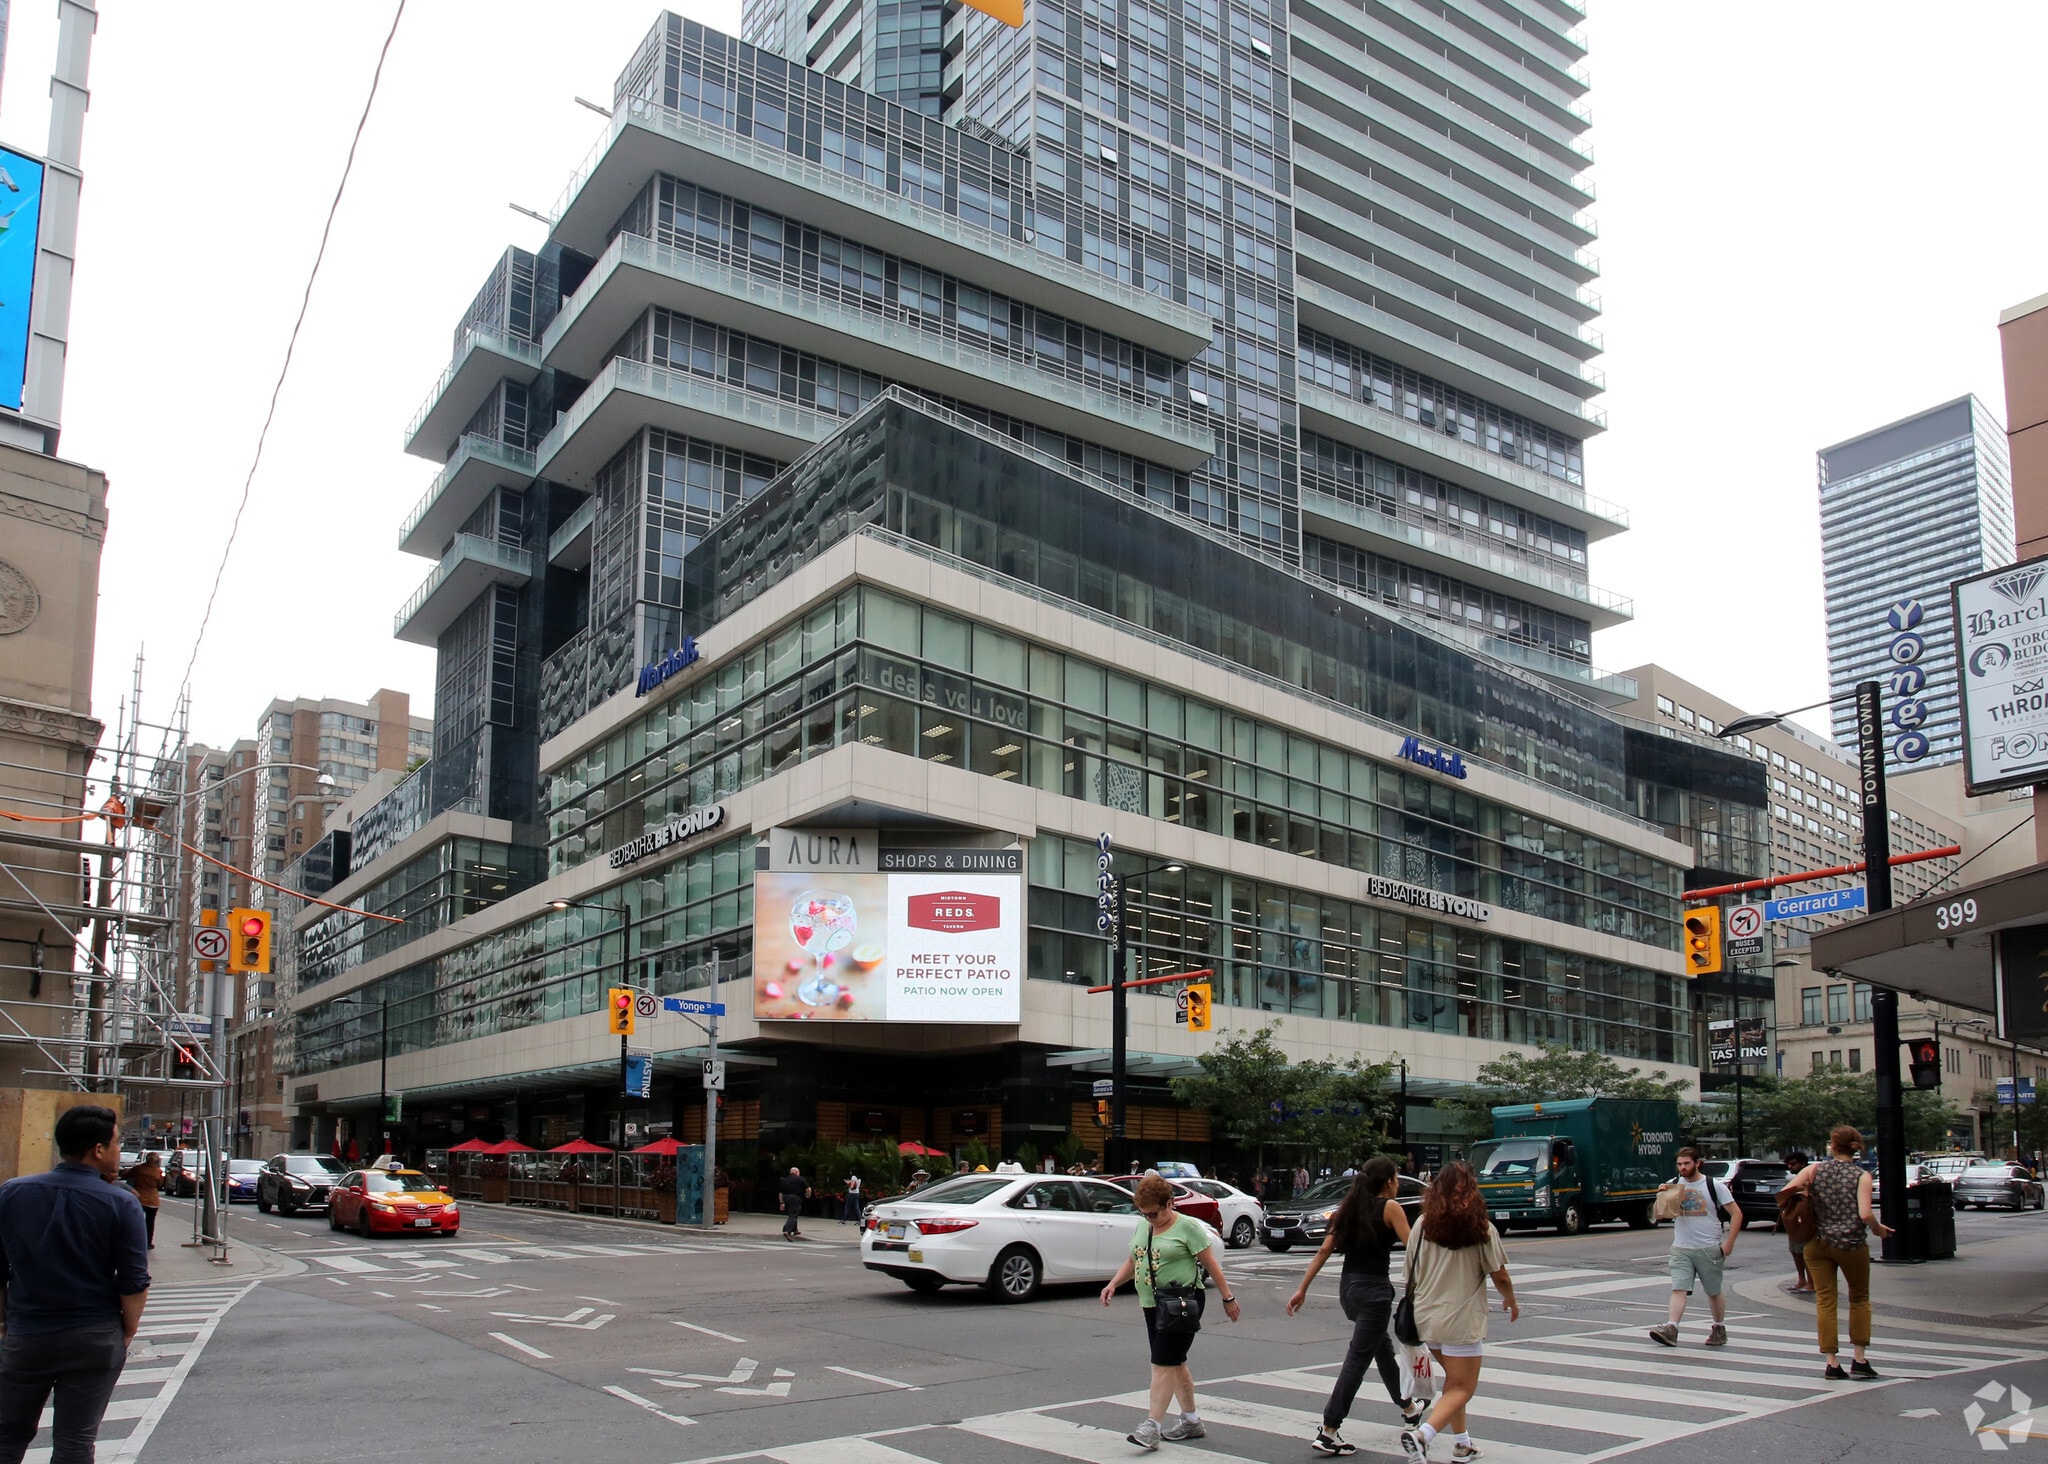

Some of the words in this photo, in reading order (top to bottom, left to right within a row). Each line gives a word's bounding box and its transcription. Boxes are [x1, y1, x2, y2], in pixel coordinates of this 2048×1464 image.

[635, 635, 699, 698] Marshalls
[1398, 735, 1468, 780] Marshalls
[1859, 692, 1877, 805] DOWNTOWN
[654, 806, 721, 850] BEYOND
[788, 836, 860, 865] AURA
[885, 854, 937, 868] SHOPS
[944, 854, 956, 868] &
[962, 855, 1017, 869] DINING
[1430, 892, 1493, 921] BEYOND
[1777, 893, 1838, 916] Gerrard
[1841, 890, 1851, 900] St
[1936, 898, 1978, 930] 399
[1730, 946, 1760, 955] EXCEPTED
[1735, 939, 1755, 948] BUSES
[911, 954, 950, 964] MEET
[956, 954, 996, 964] YOUR
[896, 968, 962, 979] PERFECT
[967, 969, 1010, 980] PATIO
[904, 986, 936, 996] PATIO
[940, 987, 968, 996] NOW
[972, 988, 1003, 996] OPEN
[678, 1000, 705, 1013] Yonge
[642, 1056, 654, 1098] TASTING
[1641, 1132, 1674, 1143] TORONTO
[1638, 1144, 1662, 1155] HYDRO
